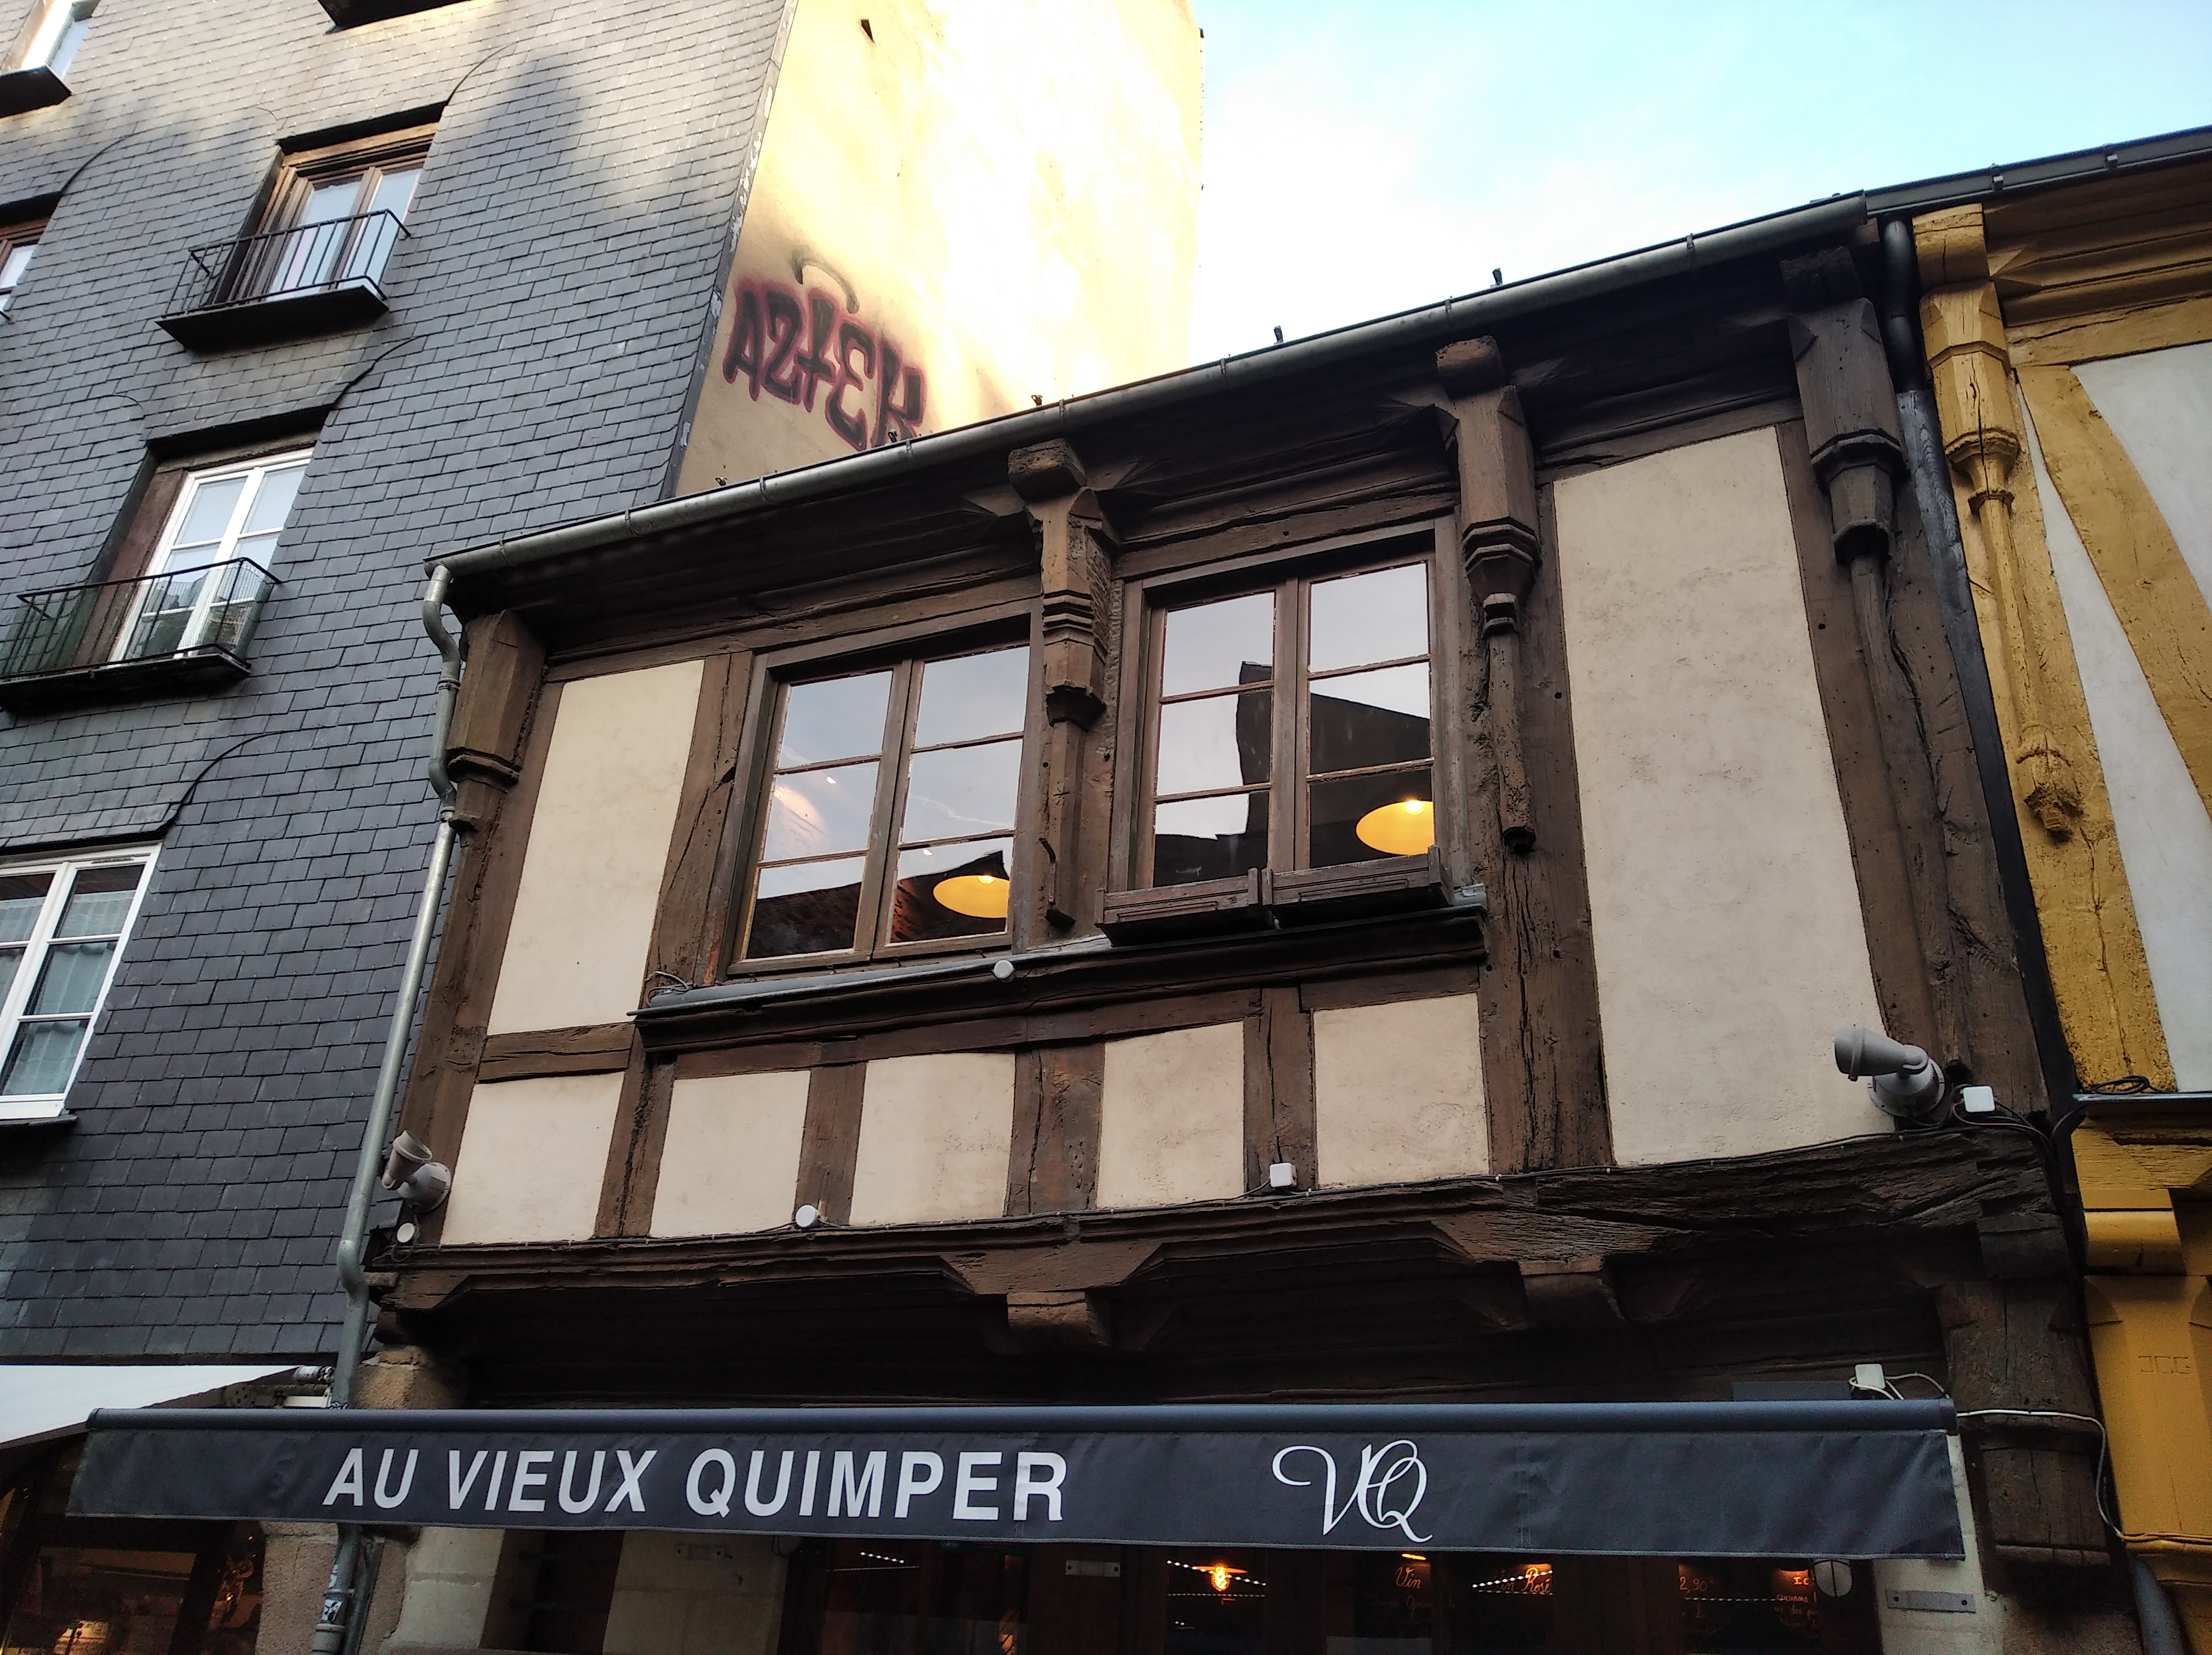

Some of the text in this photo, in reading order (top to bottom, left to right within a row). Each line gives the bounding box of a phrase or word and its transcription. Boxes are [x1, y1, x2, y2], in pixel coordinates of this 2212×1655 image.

[321, 1448, 1068, 1521] AU VIEUX QUIMPER
[1396, 1566, 1422, 1589] Vin
[1521, 1567, 1551, 1594] Rosé
